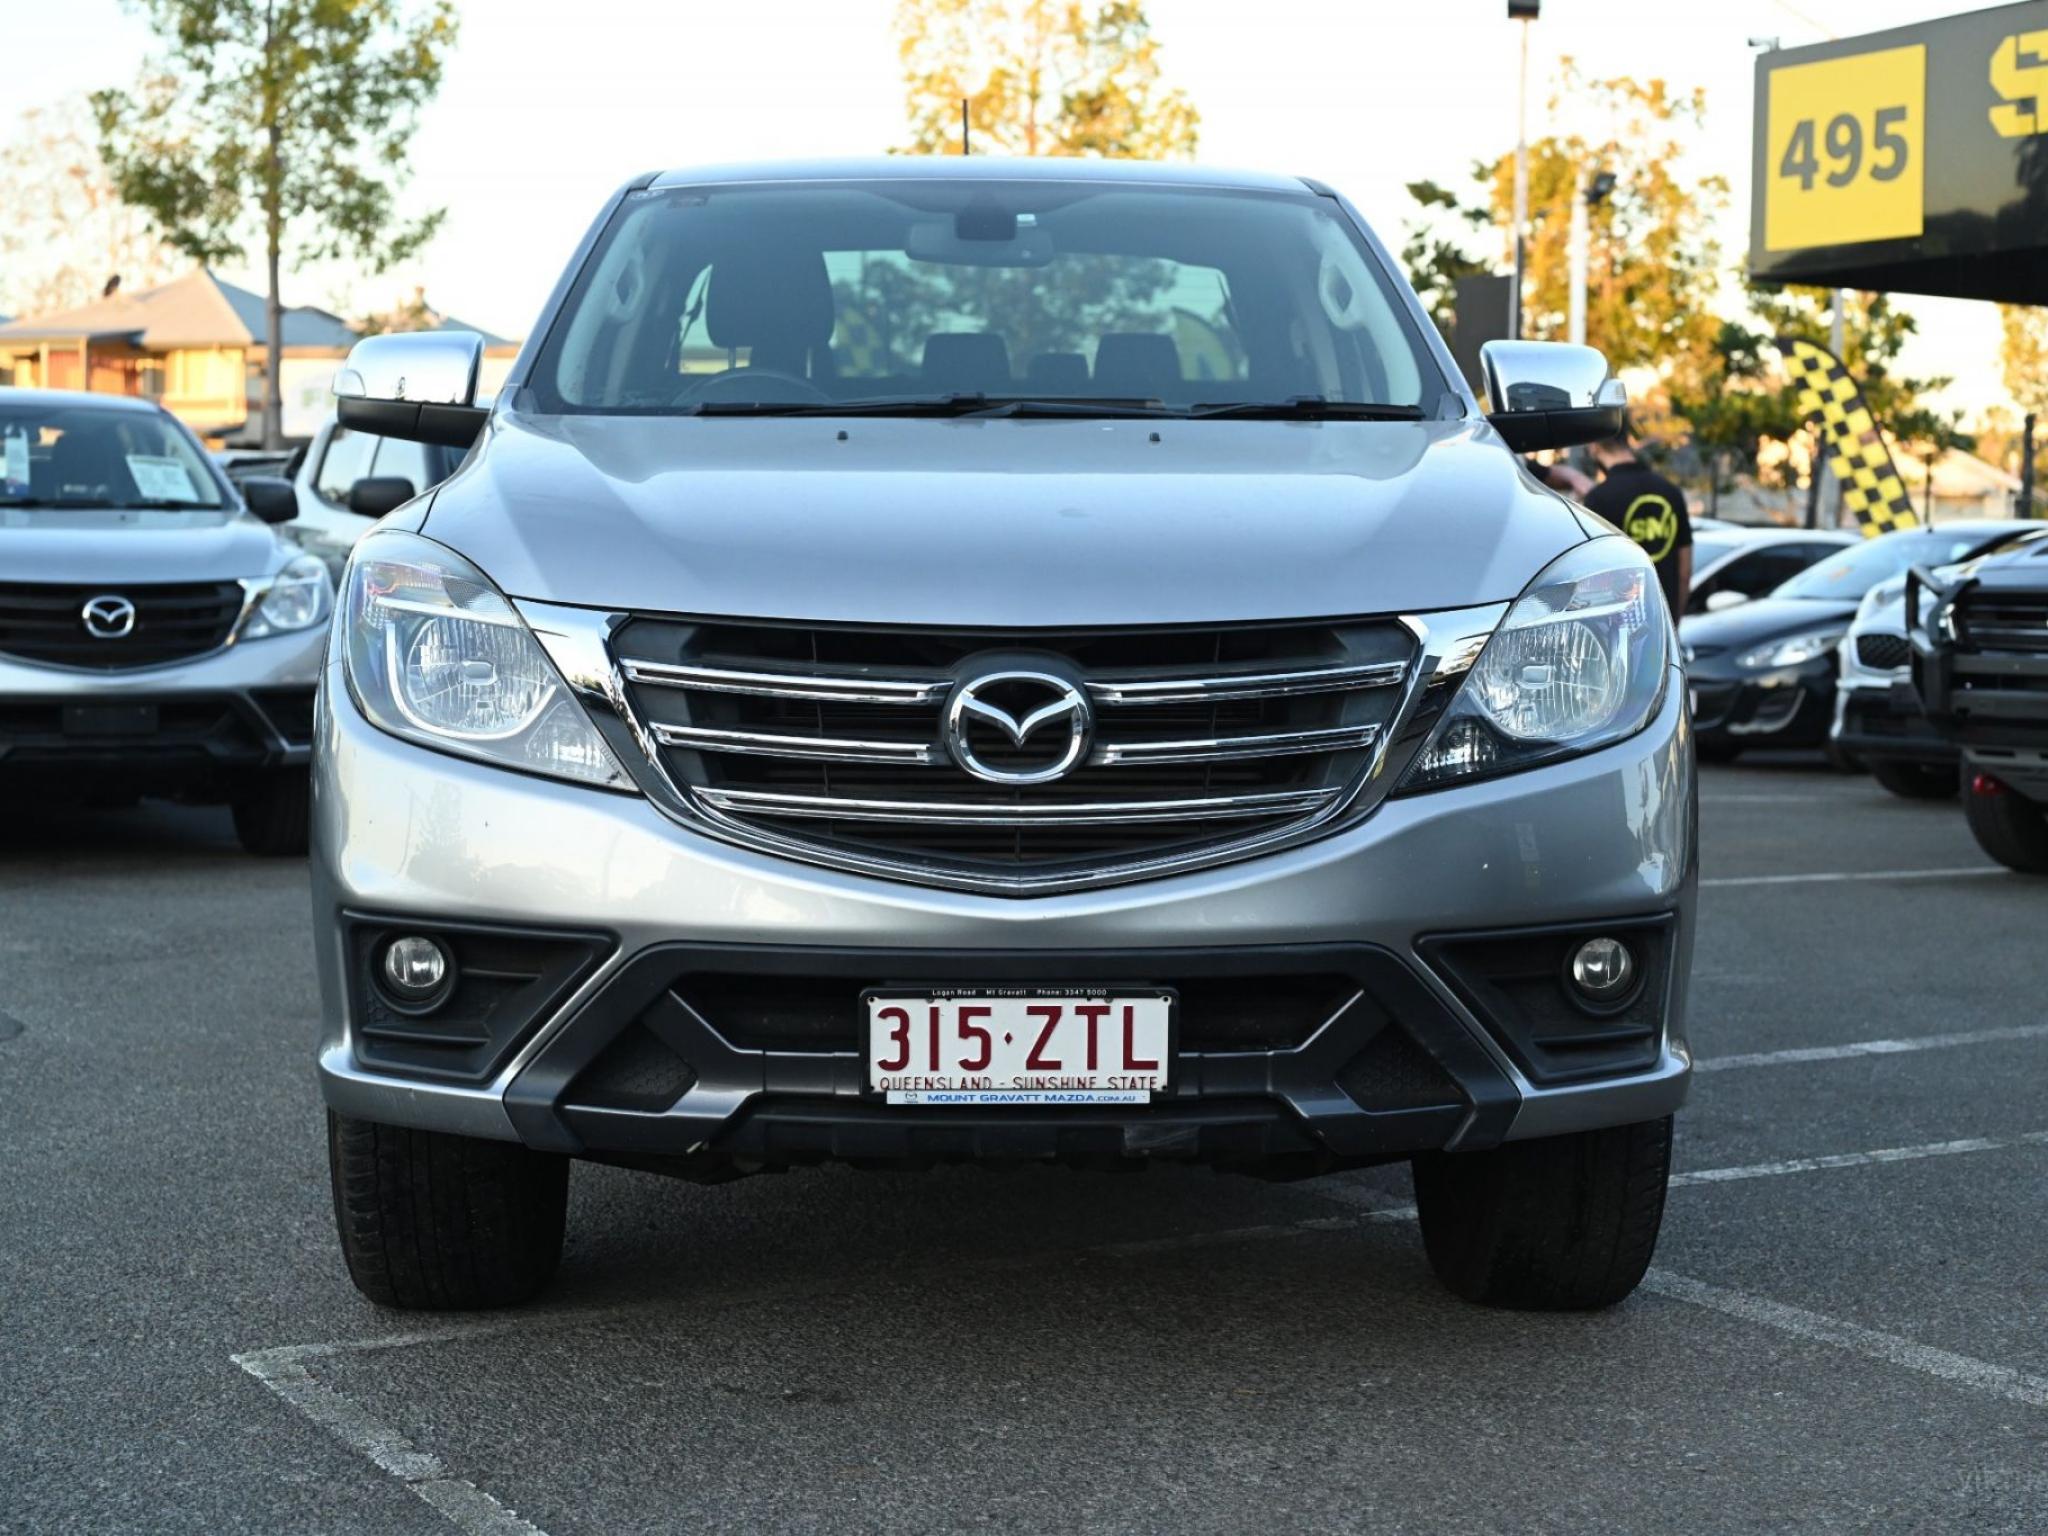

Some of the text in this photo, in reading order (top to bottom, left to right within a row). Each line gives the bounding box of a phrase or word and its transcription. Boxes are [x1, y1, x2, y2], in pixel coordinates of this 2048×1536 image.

[1779, 105, 1909, 191] 495
[932, 989, 955, 997] Logan
[880, 1076, 993, 1090] QUEENSLAND
[1012, 1076, 1097, 1090] SUNSHINE
[1107, 1076, 1158, 1090] STATE
[927, 1094, 977, 1102] MOUNT
[980, 1094, 1041, 1102] GRAVATT
